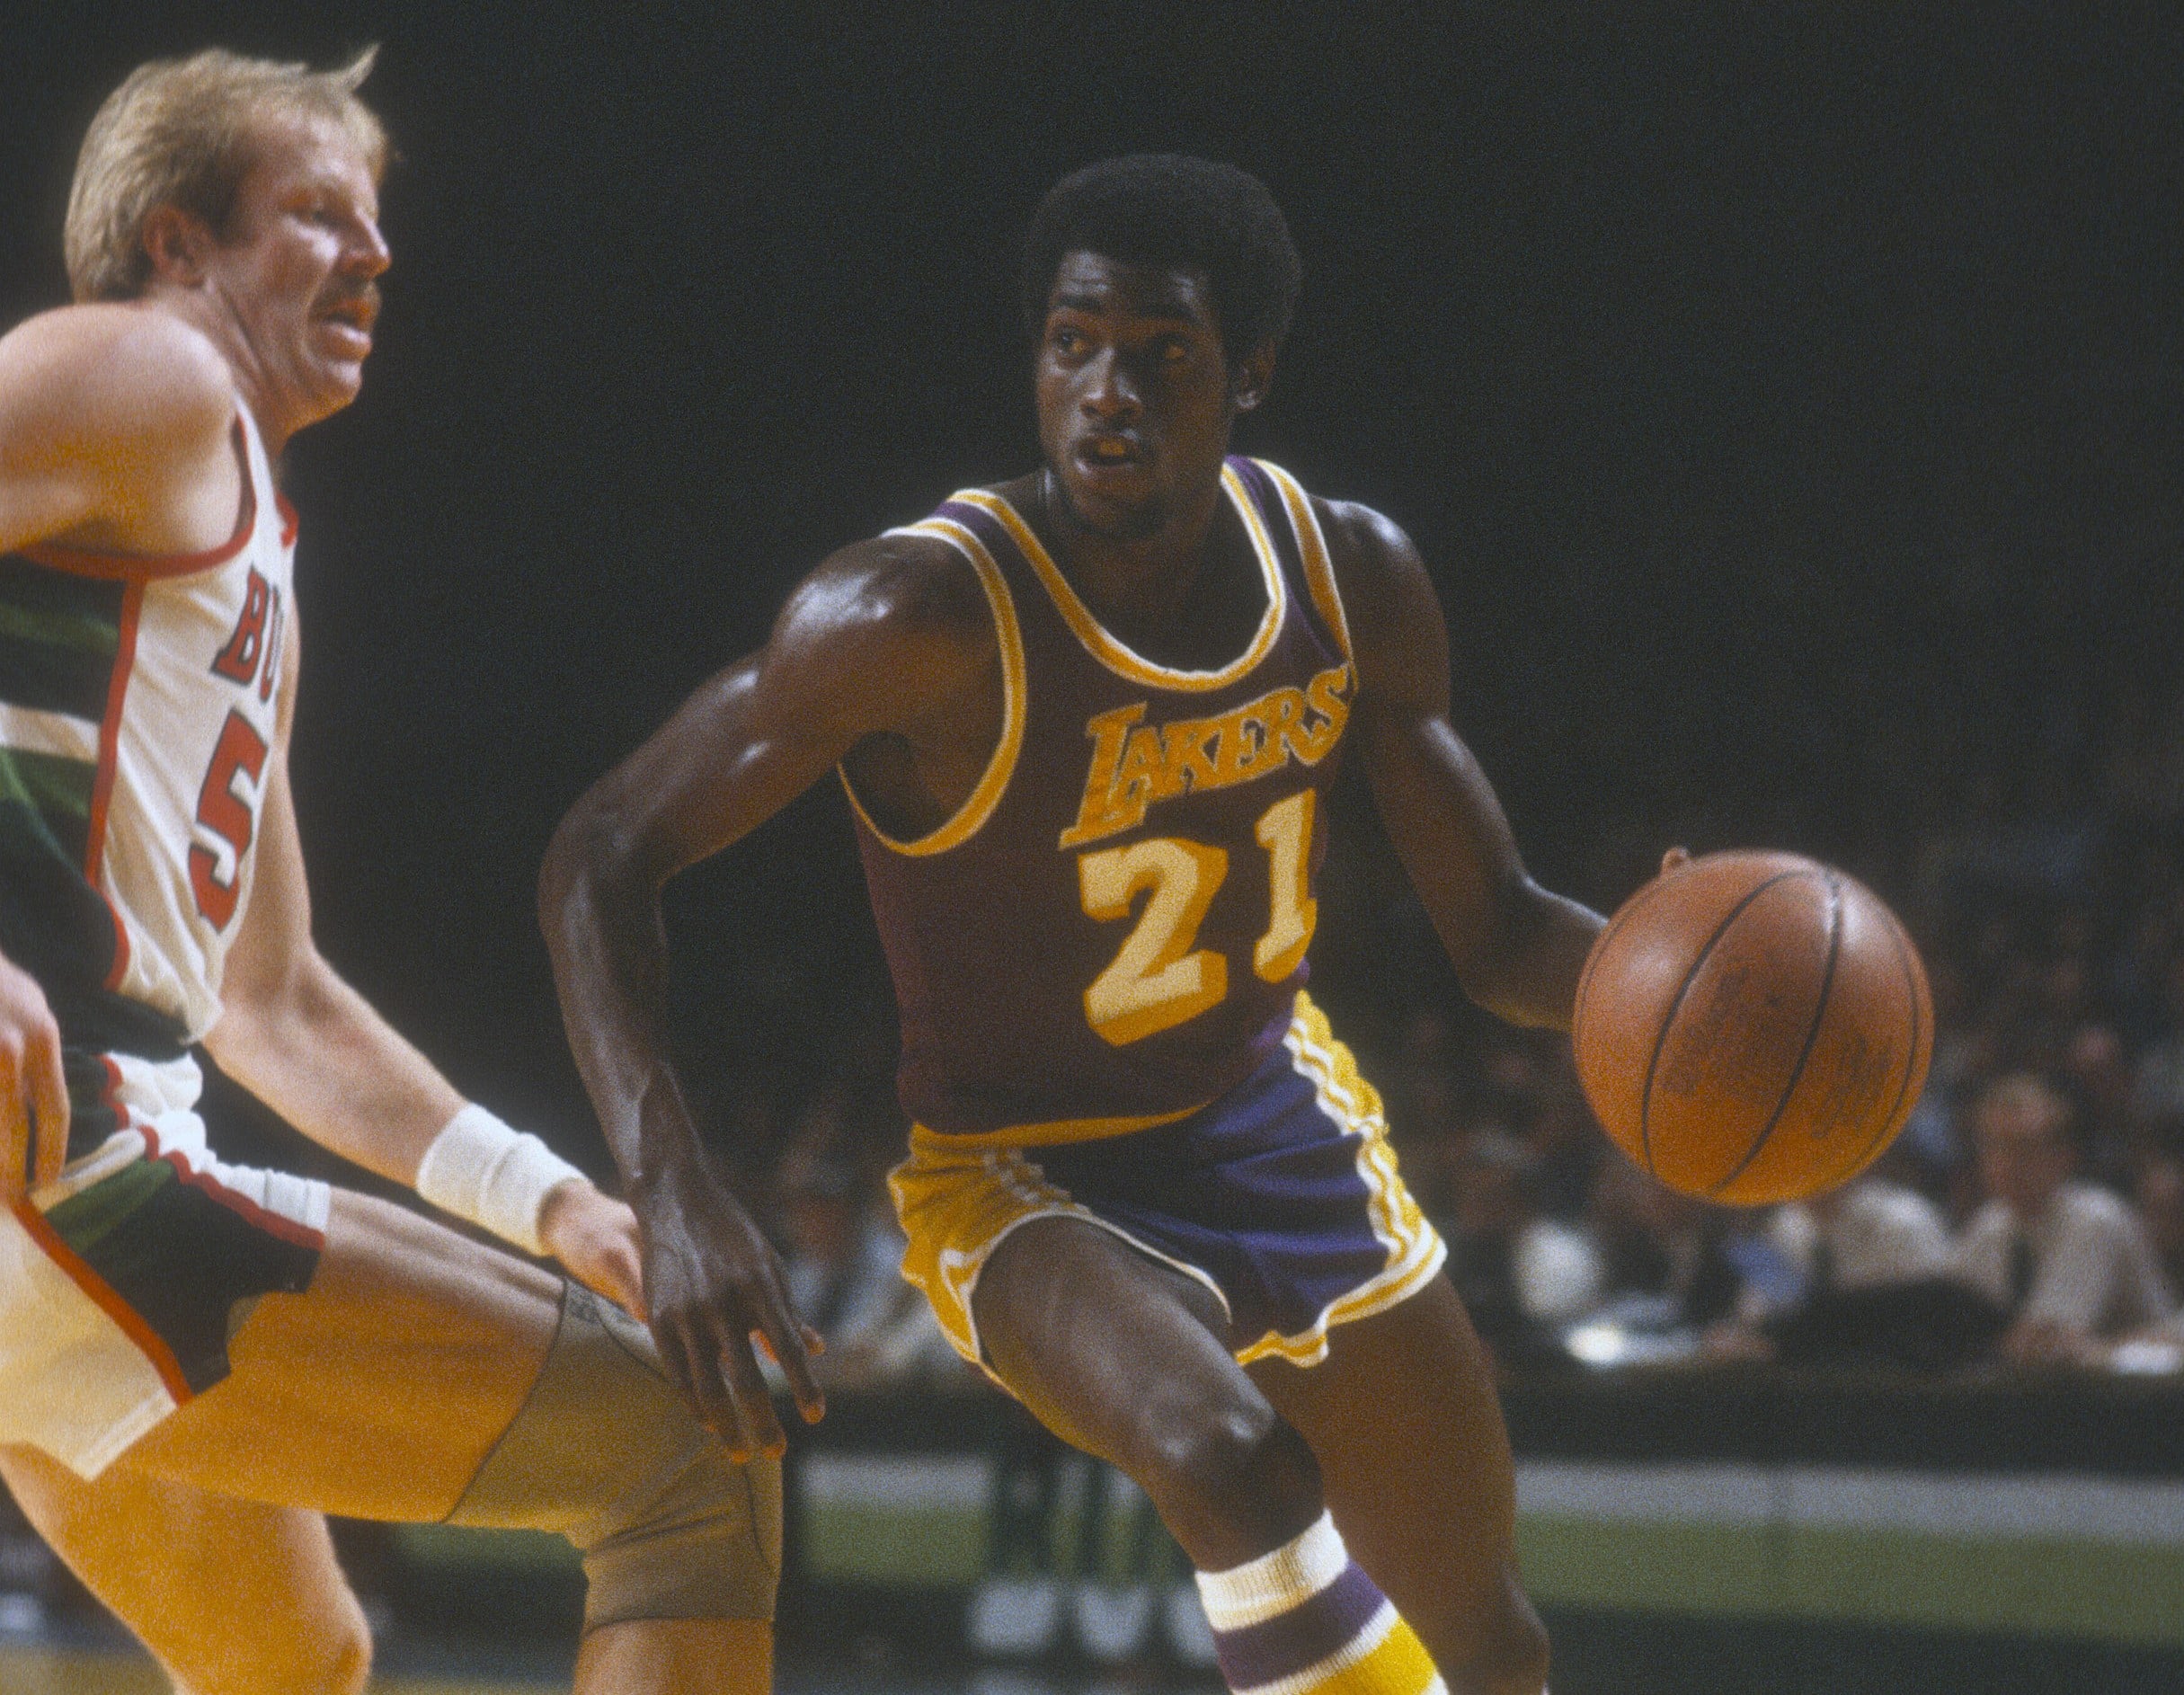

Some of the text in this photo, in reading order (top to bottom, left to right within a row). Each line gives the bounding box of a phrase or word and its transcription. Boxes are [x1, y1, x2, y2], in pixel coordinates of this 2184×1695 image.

[188, 706, 269, 936] 5
[1059, 663, 1350, 851] LAKERS
[1078, 787, 1318, 1047] 21
